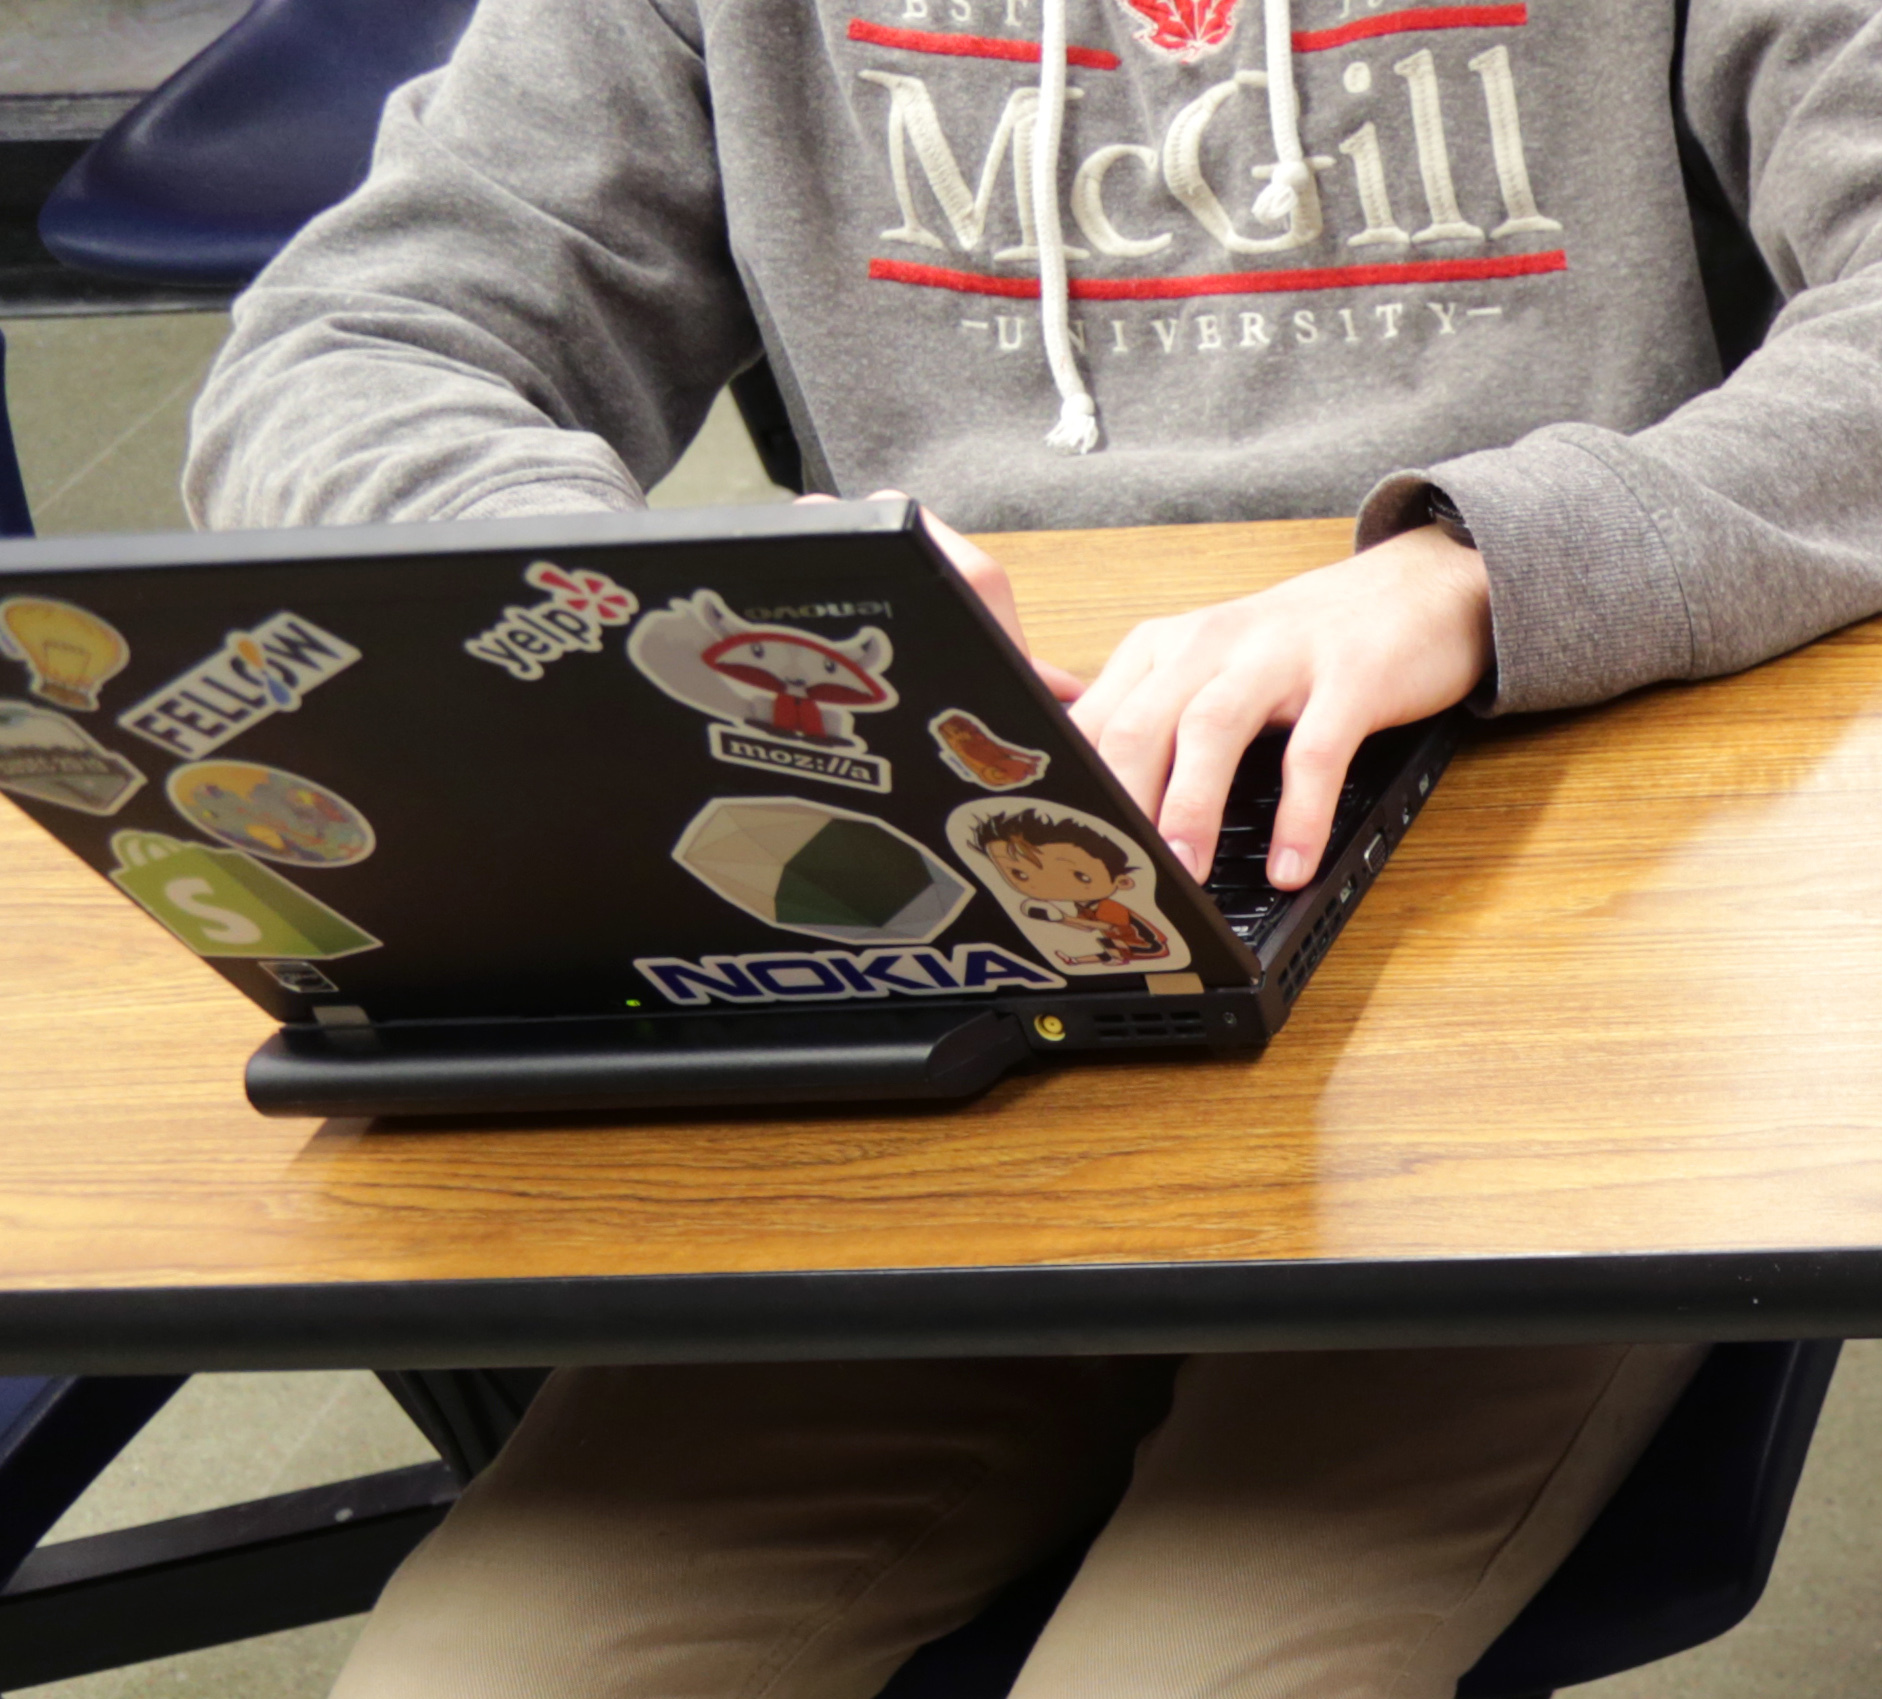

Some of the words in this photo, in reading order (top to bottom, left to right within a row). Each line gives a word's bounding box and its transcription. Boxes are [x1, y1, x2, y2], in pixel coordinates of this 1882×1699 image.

[858, 45, 1562, 260] McGill
[138, 621, 342, 754] FELLOW
[477, 608, 590, 673] yelp
[639, 946, 1057, 1000] NOKIA
